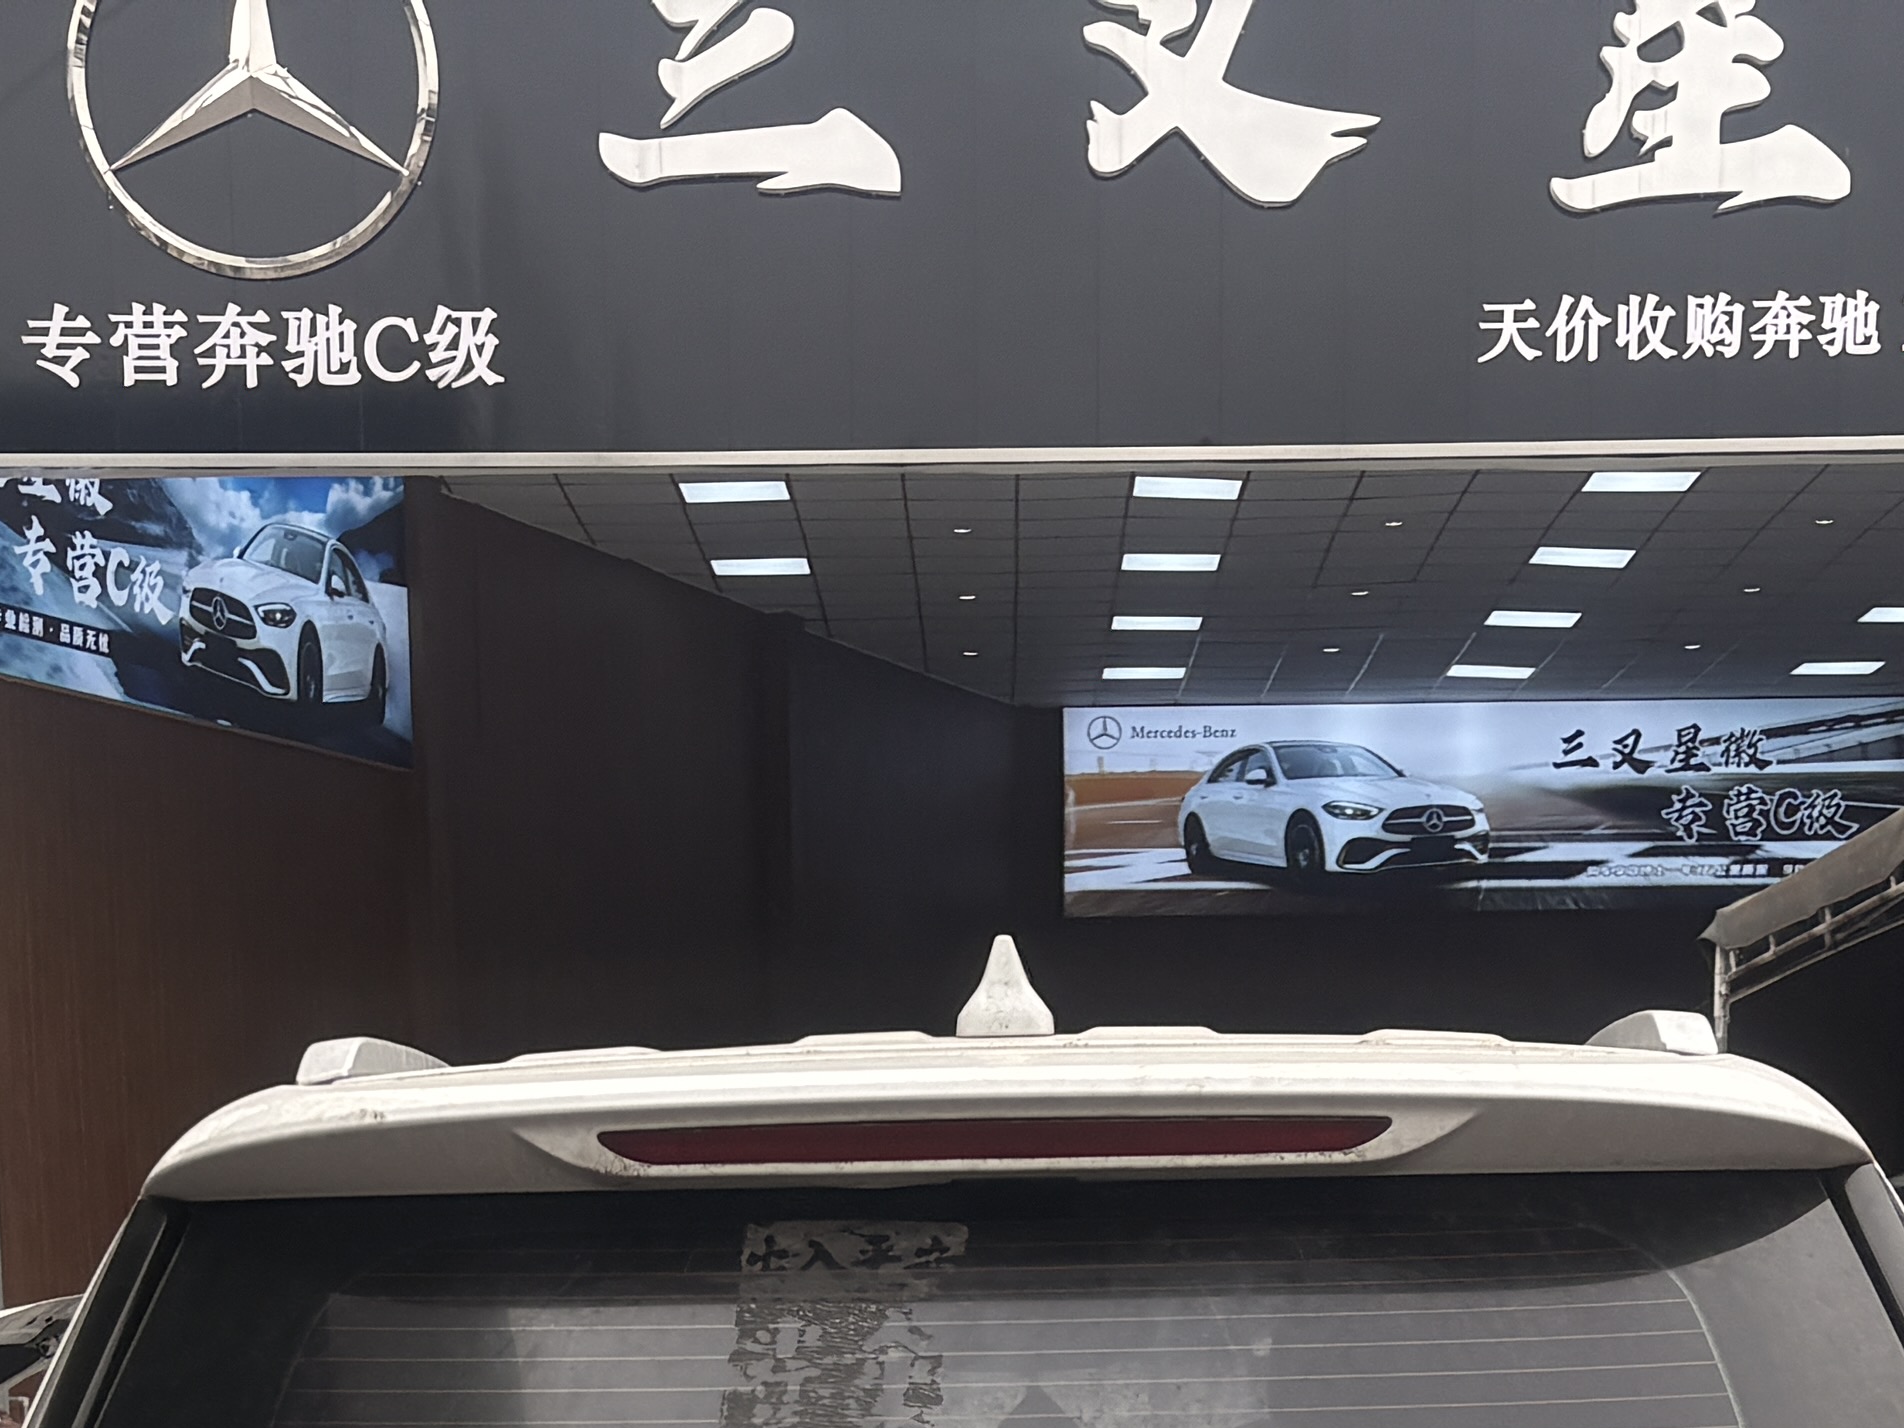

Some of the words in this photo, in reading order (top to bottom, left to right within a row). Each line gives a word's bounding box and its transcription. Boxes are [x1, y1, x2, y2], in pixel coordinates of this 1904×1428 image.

[20, 301, 506, 389] 专营奔驰C级
[1477, 289, 1883, 363] 天价收购奔驰
[13, 515, 174, 625] 专营C级
[1130, 725, 1237, 739] Mercedes-Benz
[1552, 722, 1774, 775] 三叉星徽
[1661, 784, 1860, 843] 专营C级
